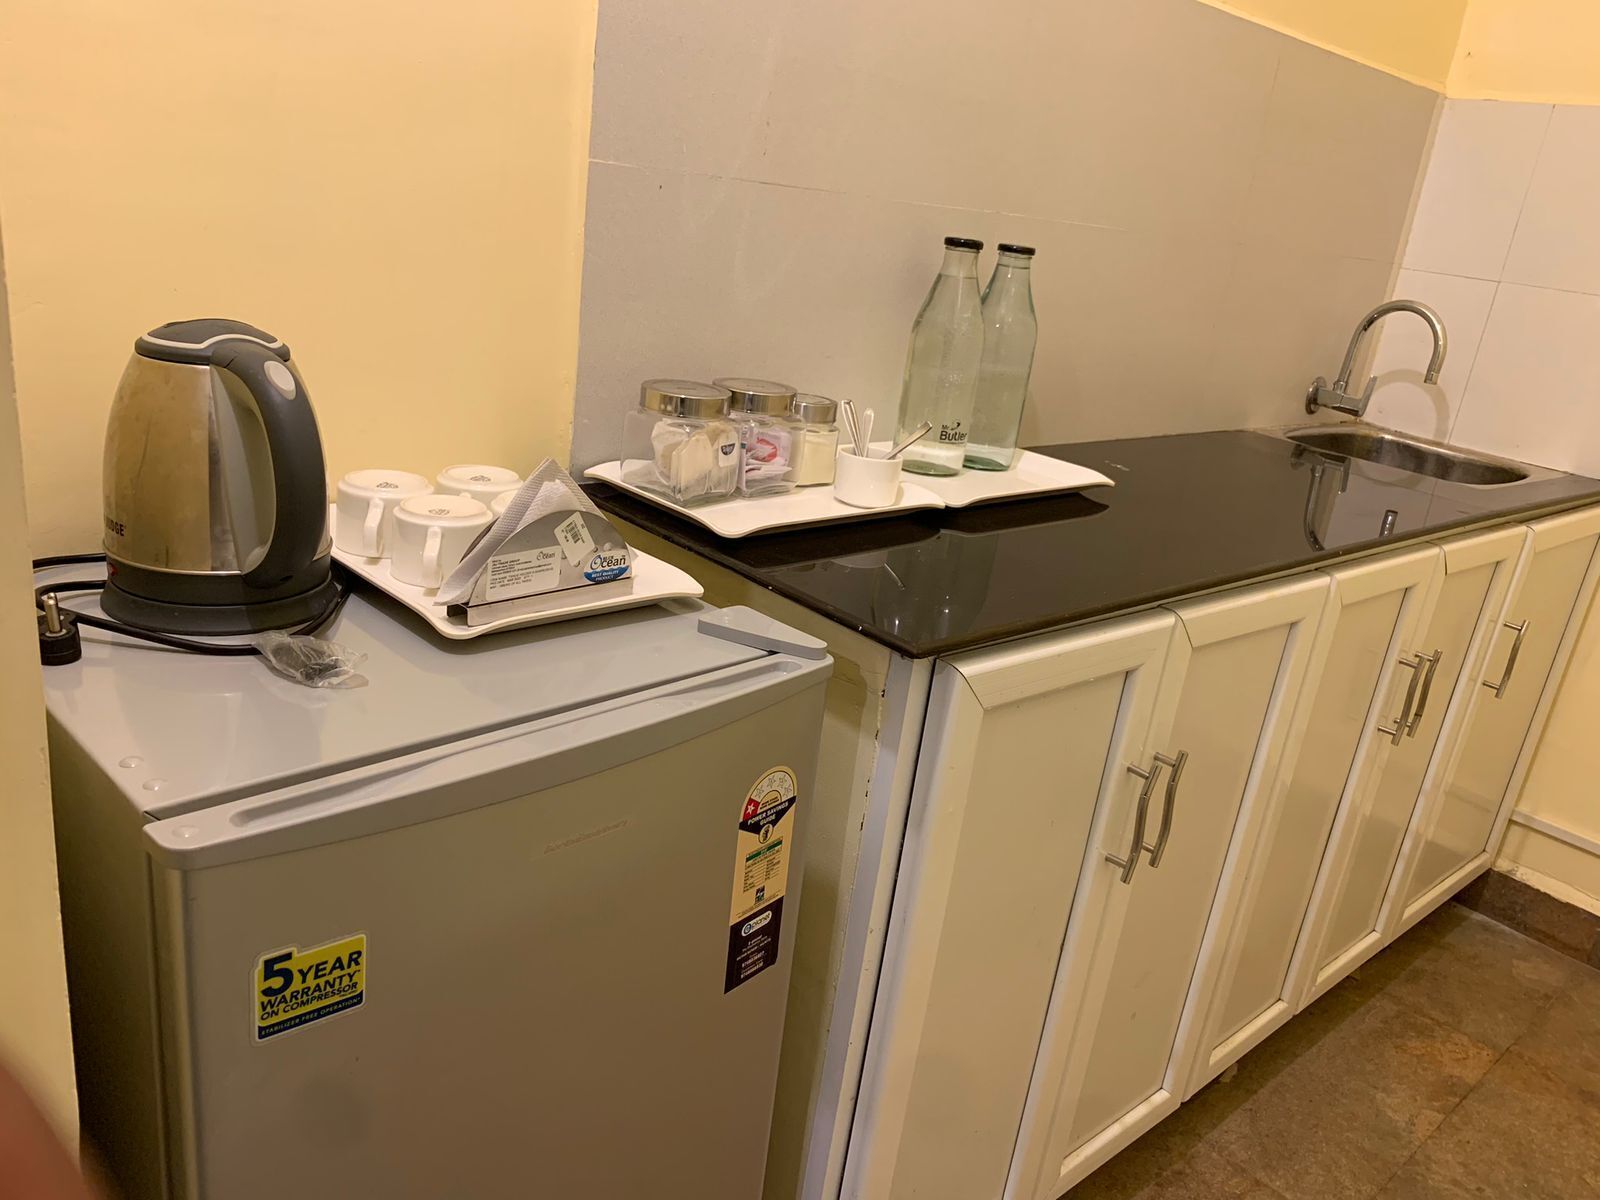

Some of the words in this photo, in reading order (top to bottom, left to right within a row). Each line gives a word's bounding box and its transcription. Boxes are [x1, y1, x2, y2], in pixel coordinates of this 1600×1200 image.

[940, 430, 967, 441] Butler
[767, 800, 789, 816] SAVINGS
[260, 952, 294, 998] 5
[297, 950, 363, 984] YEAR
[261, 970, 357, 1012] WARRANTY
[260, 1008, 280, 1021] ON
[283, 981, 358, 1014] COMPRESSOR
